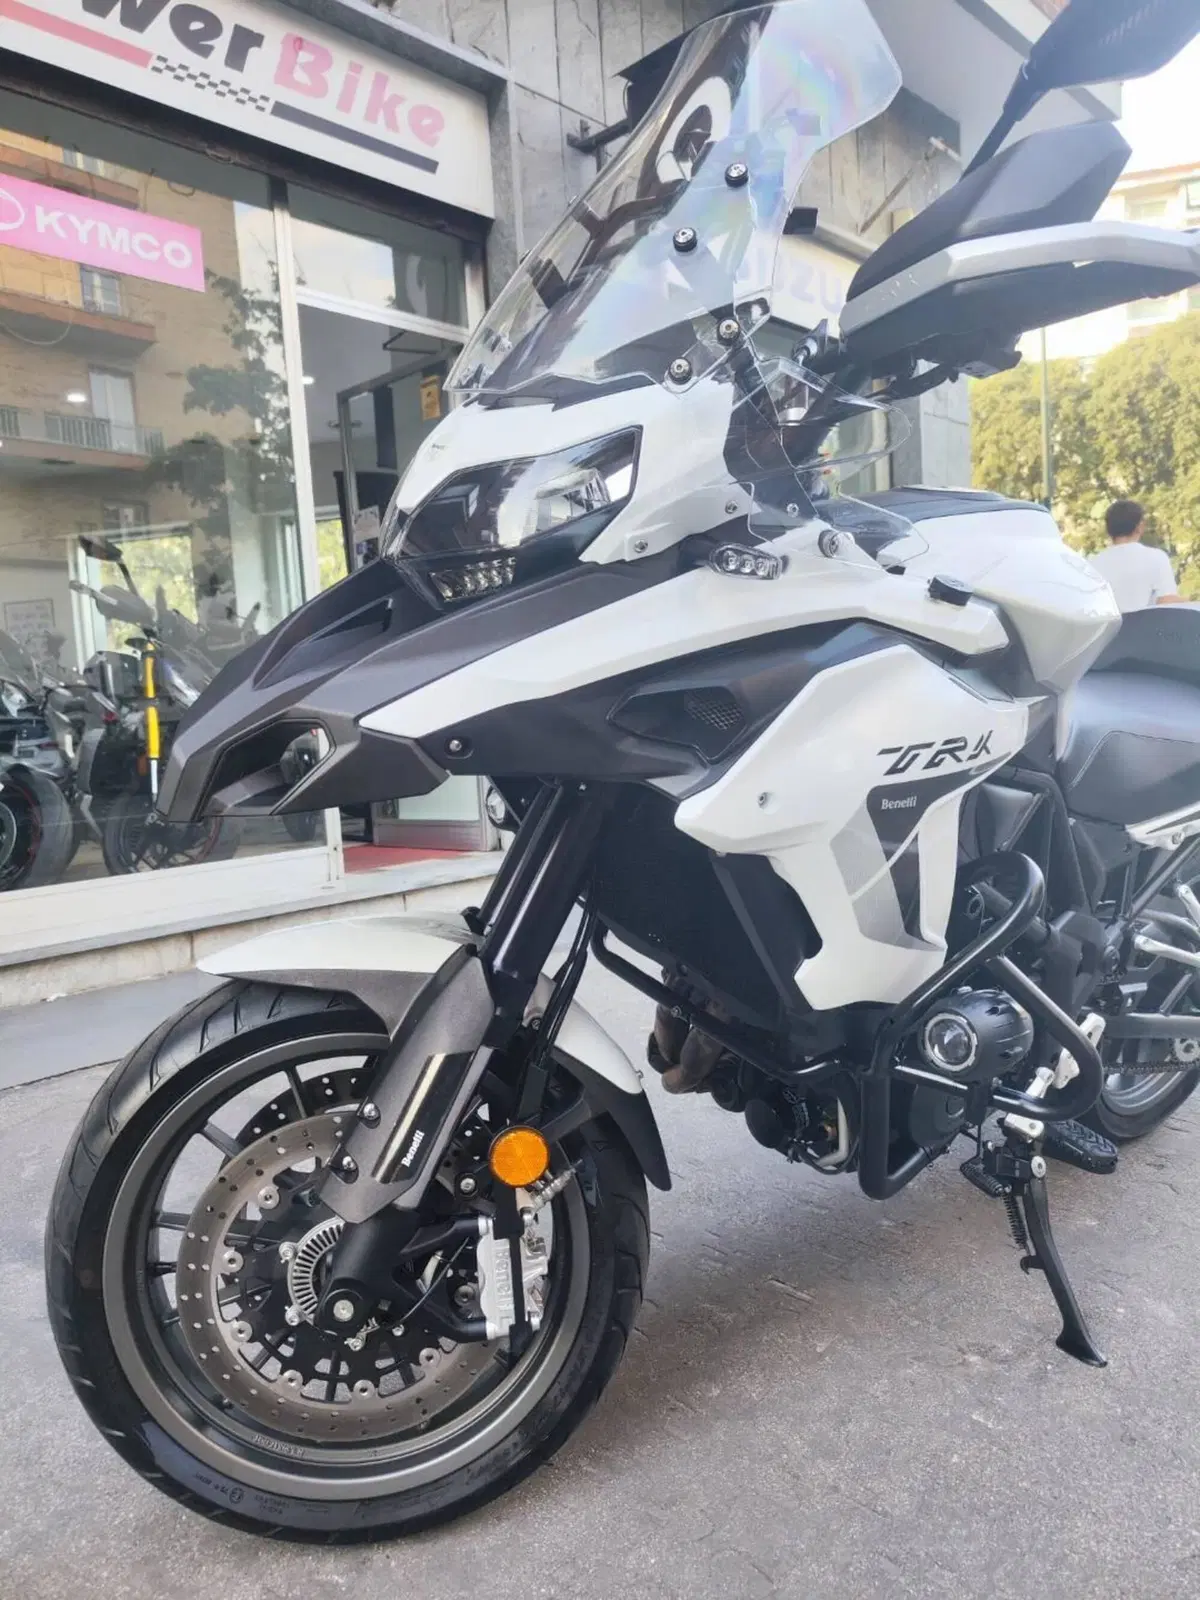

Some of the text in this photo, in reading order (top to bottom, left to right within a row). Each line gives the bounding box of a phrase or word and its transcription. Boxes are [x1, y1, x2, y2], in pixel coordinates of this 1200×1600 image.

[273, 32, 446, 147] Bike
[35, 204, 193, 269] KYMCO
[877, 730, 994, 776] TRK
[880, 796, 918, 810] Benelli
[401, 1130, 425, 1168] Benelli
